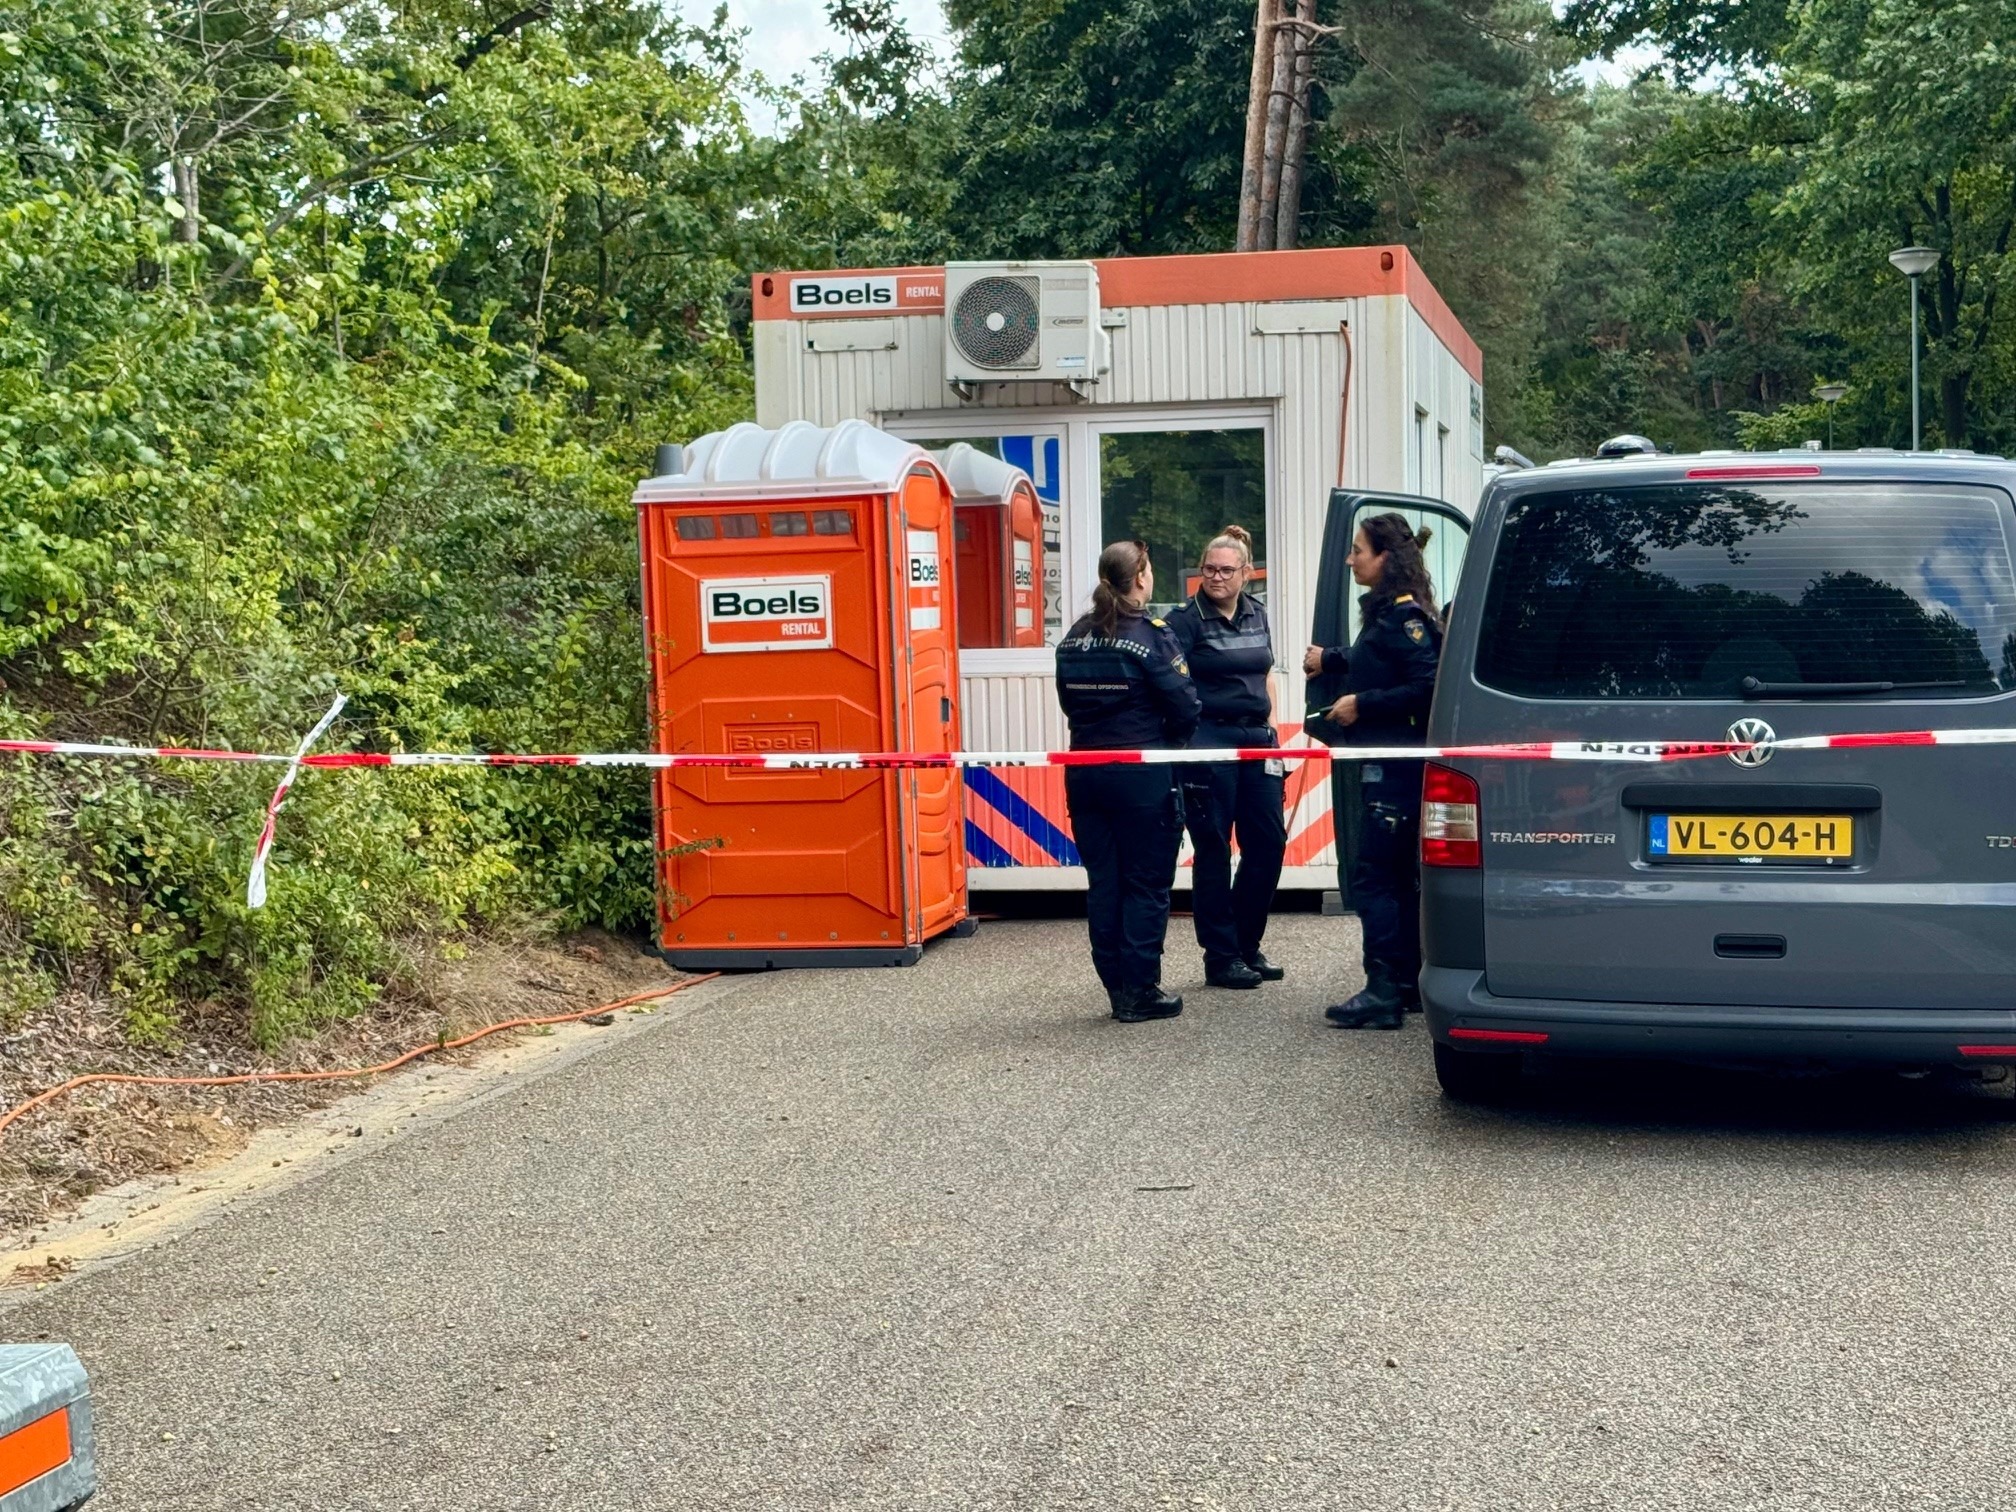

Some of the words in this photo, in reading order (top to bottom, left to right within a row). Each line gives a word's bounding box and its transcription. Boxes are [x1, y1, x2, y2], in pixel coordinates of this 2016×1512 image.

[796, 283, 892, 306] Boels
[905, 286, 942, 298] RENTAL
[712, 590, 820, 616] Boels
[780, 622, 821, 636] RENTAL
[732, 733, 814, 752] Boels
[1489, 832, 1617, 844] TRANSPORTER
[1652, 839, 1666, 849] NL
[1674, 821, 1836, 851] VL-604-H
